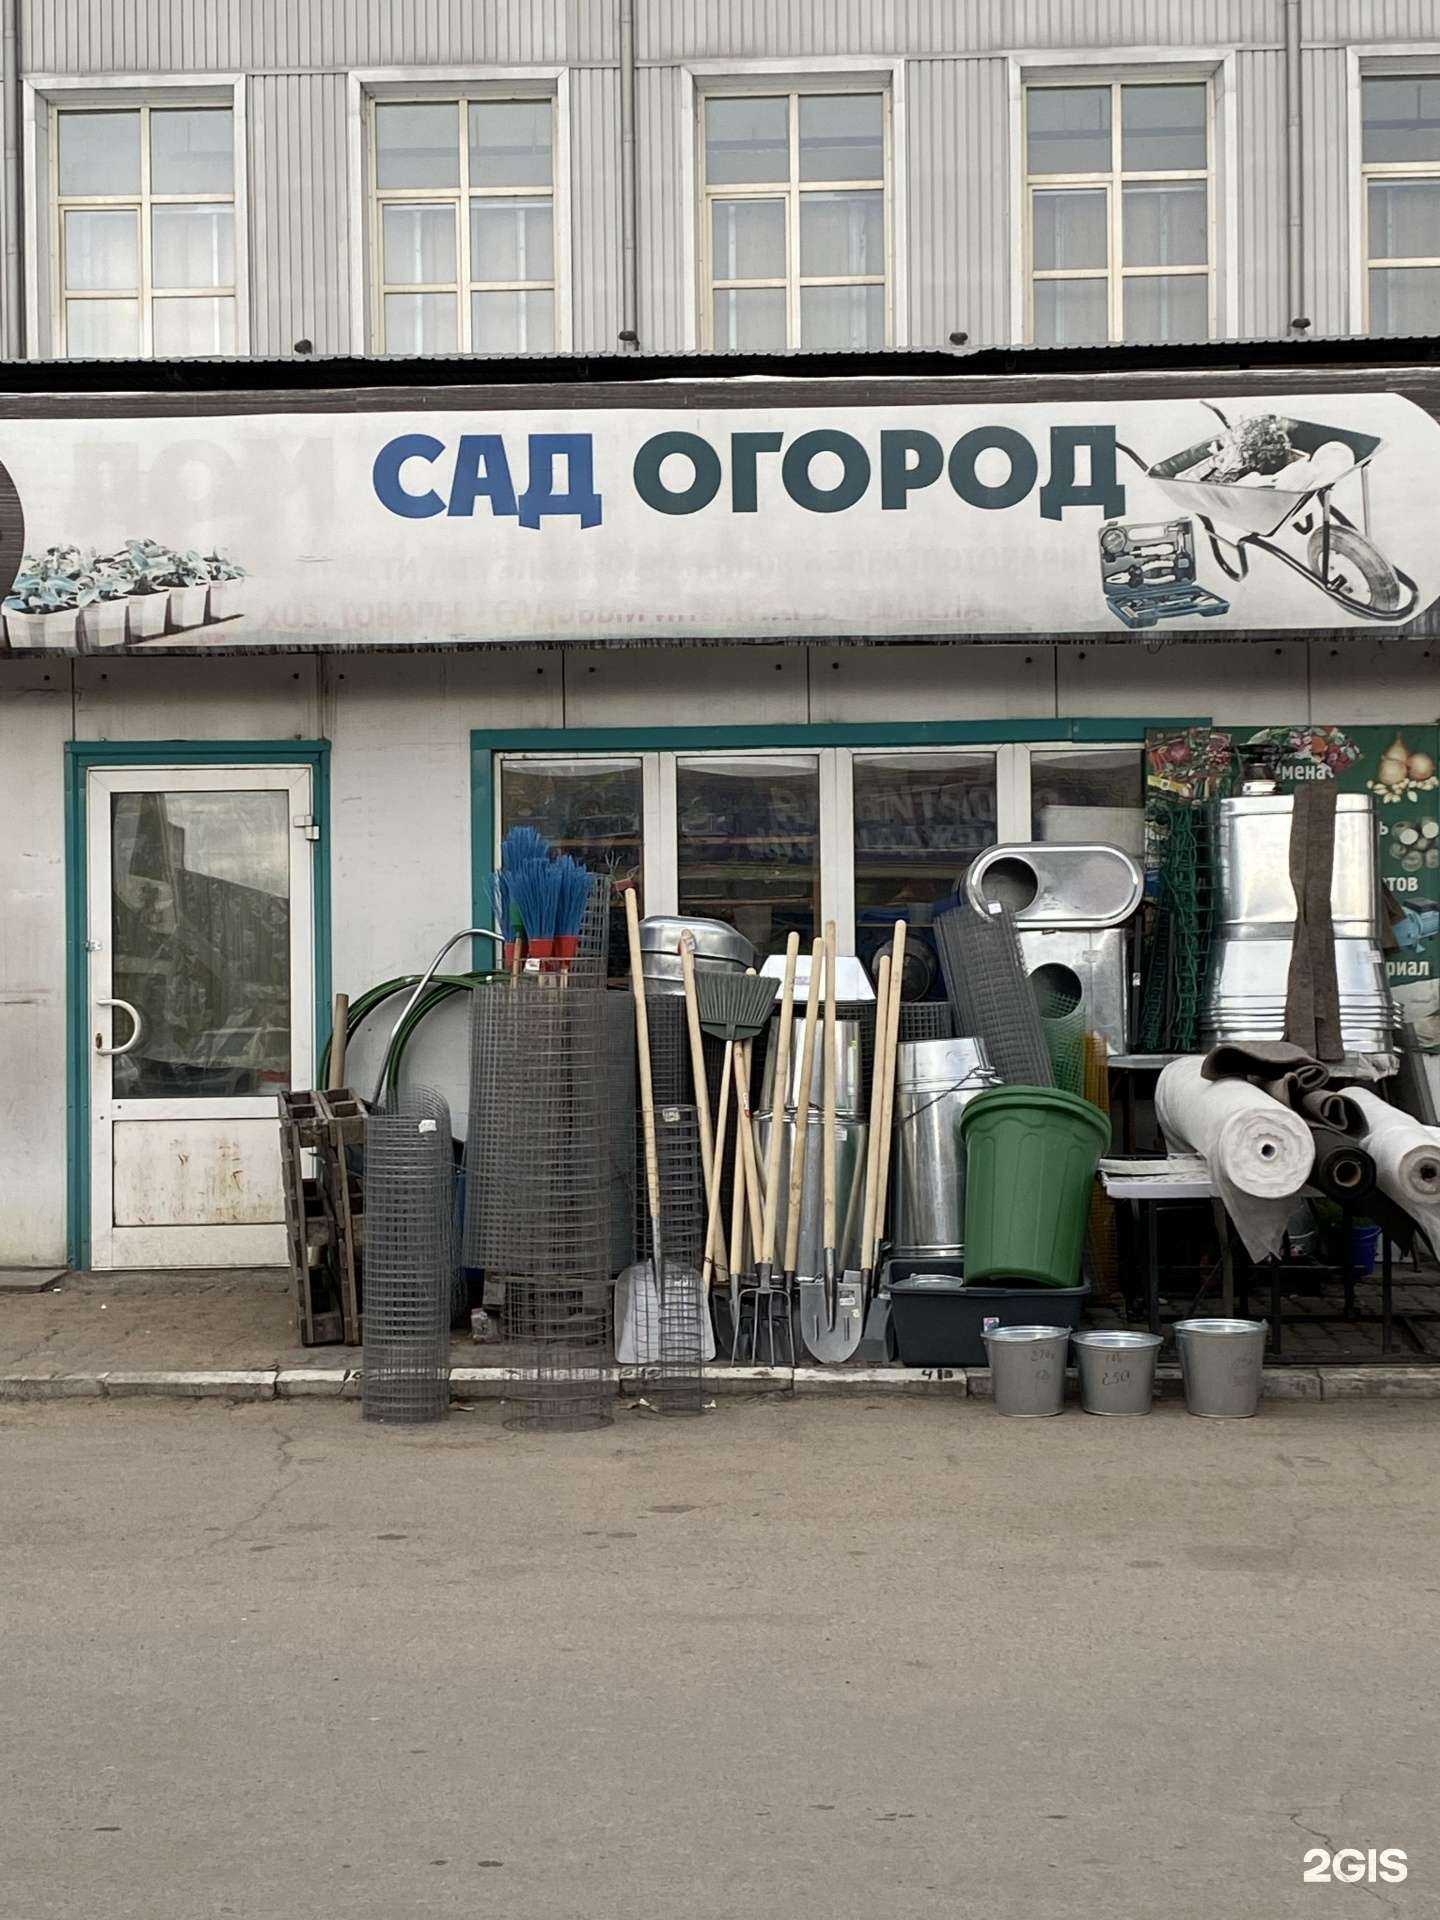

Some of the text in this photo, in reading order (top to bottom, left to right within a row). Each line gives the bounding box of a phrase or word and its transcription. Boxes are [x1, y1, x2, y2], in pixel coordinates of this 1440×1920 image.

[373, 433, 601, 530] САД
[634, 426, 1125, 519] ОГОРОД
[1275, 764, 1327, 780] мена
[1383, 876, 1419, 892] тов
